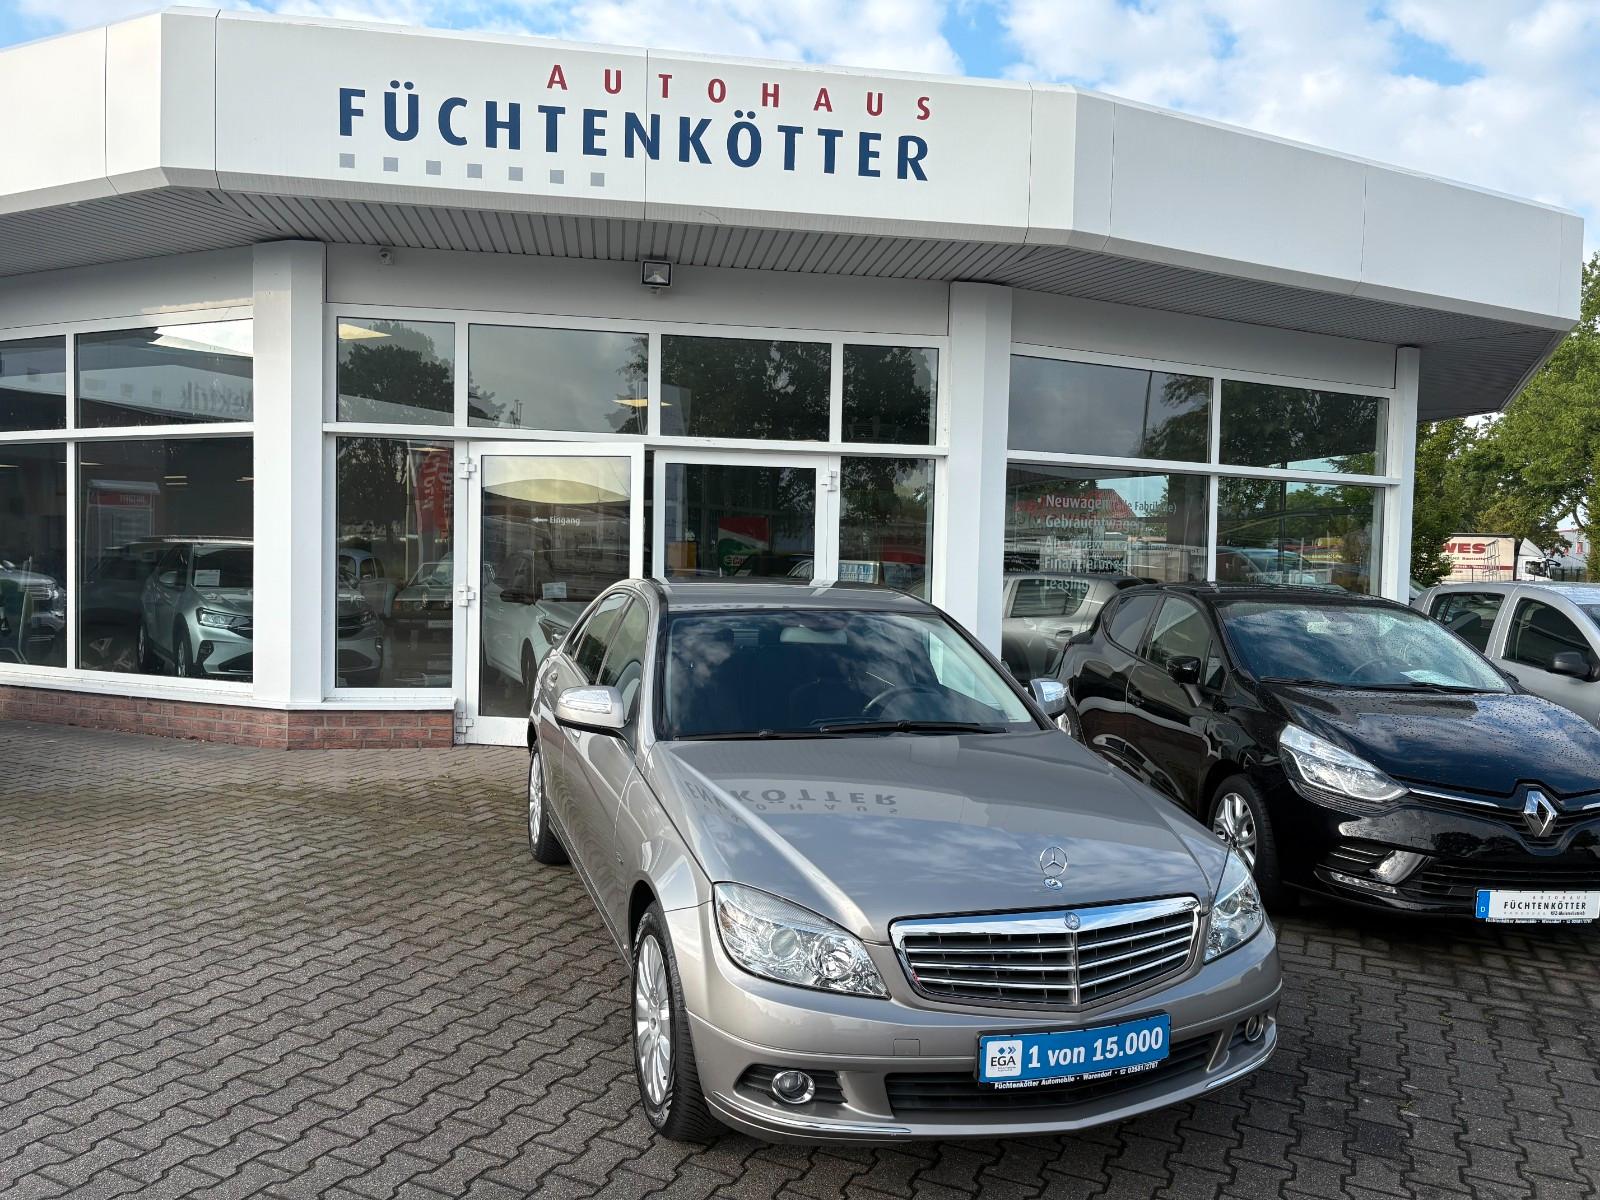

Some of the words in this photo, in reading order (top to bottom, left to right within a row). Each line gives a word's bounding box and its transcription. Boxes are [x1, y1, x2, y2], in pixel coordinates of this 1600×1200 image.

[546, 64, 932, 121] AUTOHAUS
[339, 80, 930, 182] FÜCHTENKÖTTER
[550, 515, 580, 527] Eingang
[1043, 576, 1089, 593] Leasing
[1503, 900, 1587, 910] FÜCHTENKÖTTER
[1027, 1045, 1041, 1069] 1
[1048, 1046, 1085, 1067] von
[1092, 1026, 1163, 1061] 15.000
[990, 1055, 1017, 1067] EGA
[1041, 1076, 1075, 1086] Automobile
[1082, 1069, 1112, 1081] Warendorf
